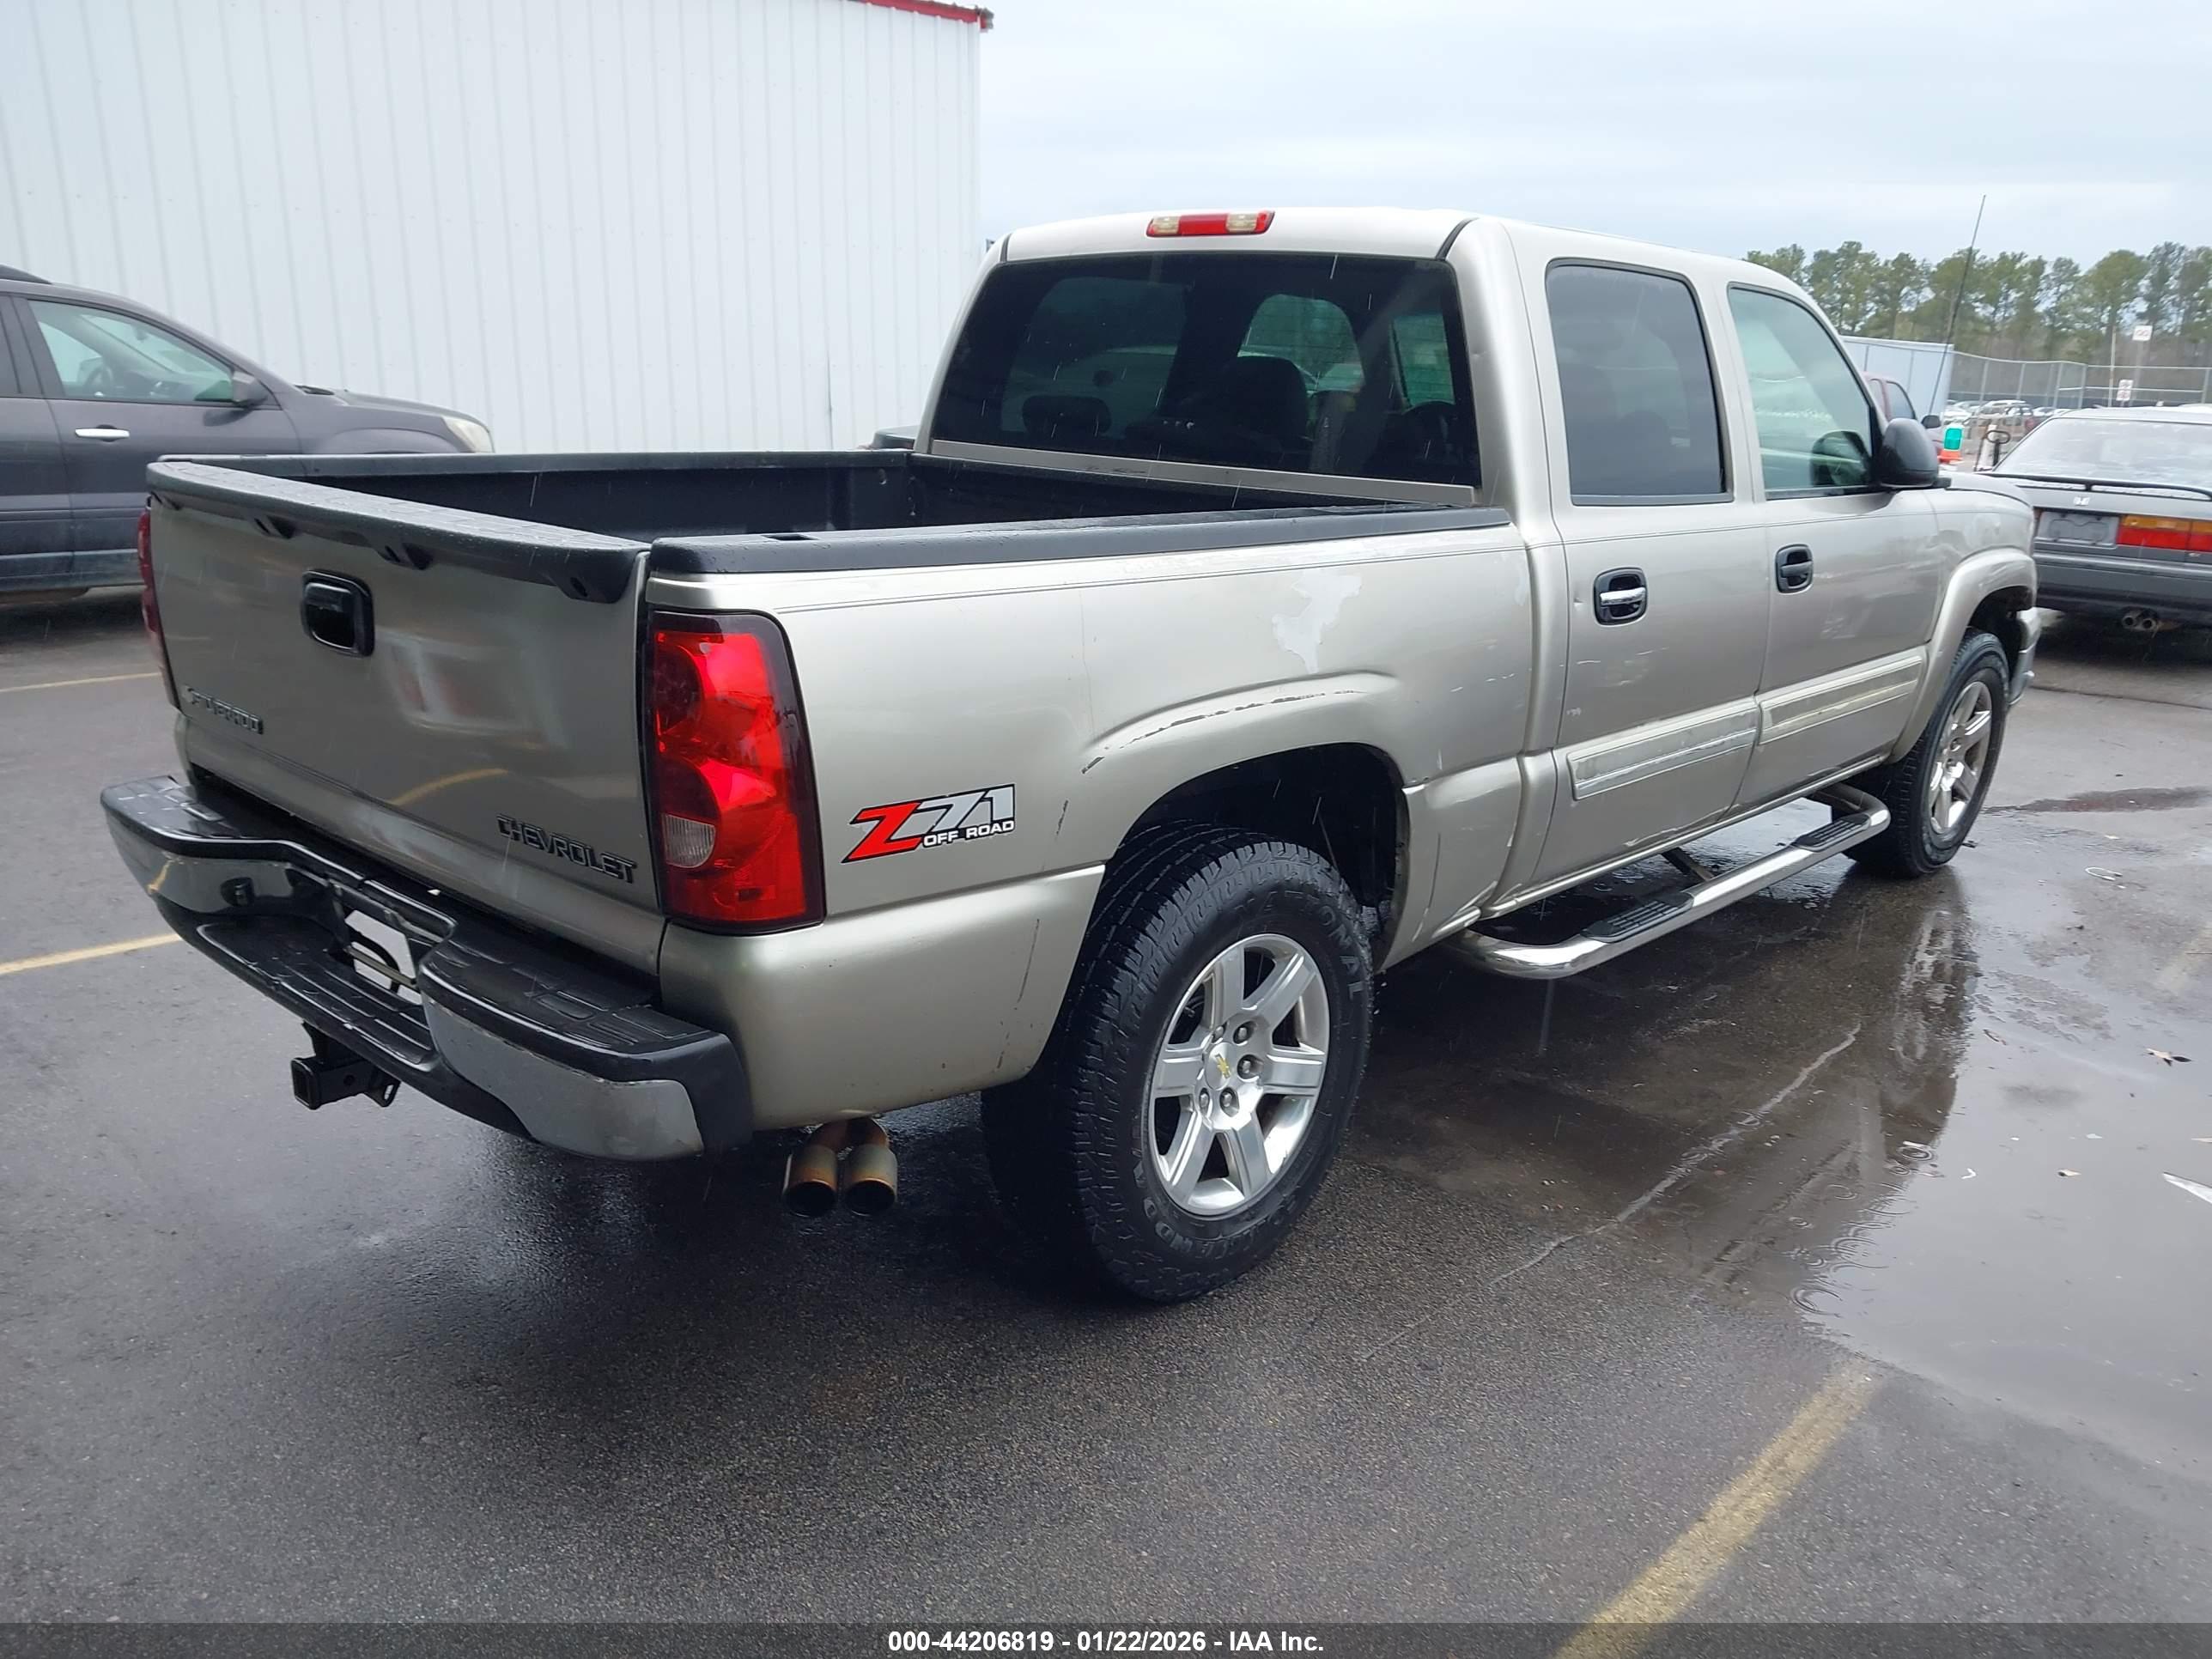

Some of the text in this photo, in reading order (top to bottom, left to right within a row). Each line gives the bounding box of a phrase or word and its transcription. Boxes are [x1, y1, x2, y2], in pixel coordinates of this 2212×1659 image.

[495, 812, 637, 884] CHEVROLET
[841, 783, 1015, 863] Z71
[923, 821, 1014, 847] OFF ROAD
